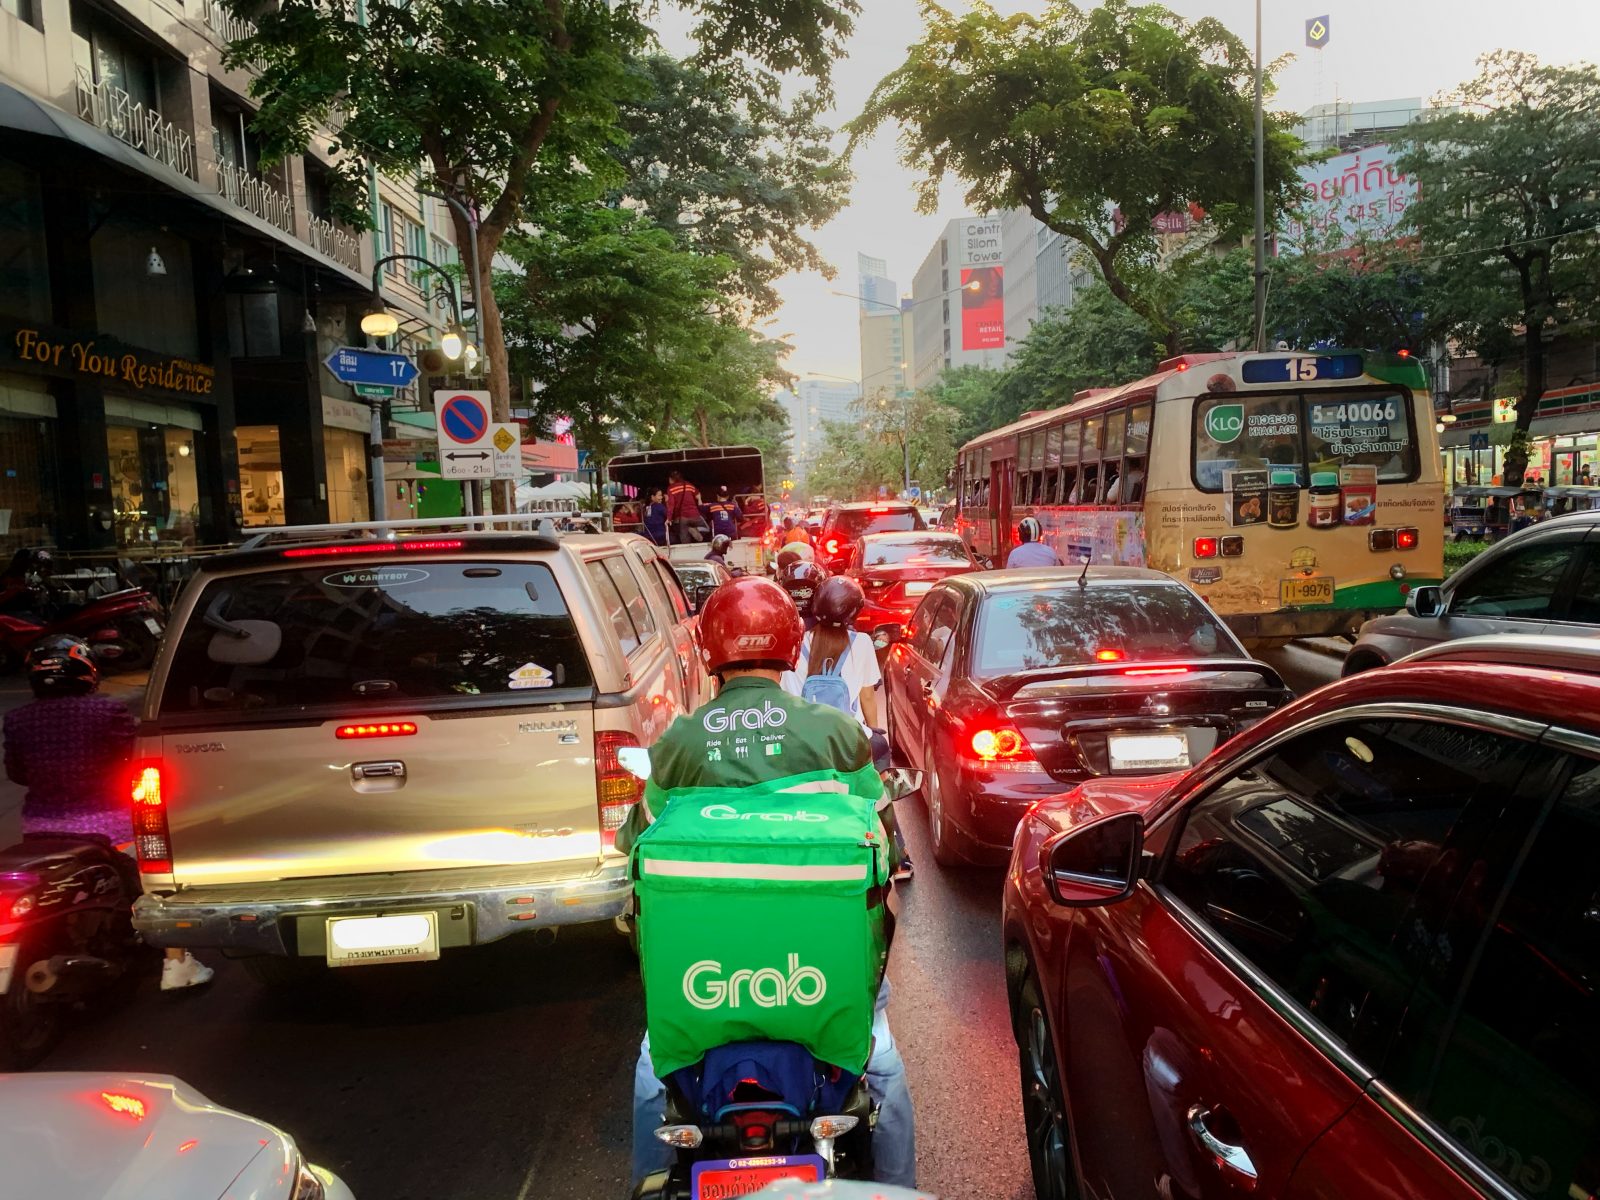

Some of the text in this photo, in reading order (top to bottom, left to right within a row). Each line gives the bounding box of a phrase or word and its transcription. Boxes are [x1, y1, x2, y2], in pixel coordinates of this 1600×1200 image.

[1302, 155, 1408, 202] ายที่ดิน
[1156, 218, 1182, 229] Silk
[967, 251, 1002, 262] Tower
[16, 329, 65, 366] For
[72, 341, 117, 376] You
[120, 354, 213, 393] Residence
[389, 360, 406, 377] 17
[1285, 358, 1318, 380] 15
[1208, 412, 1241, 432] KLO
[359, 572, 409, 582] CARRYBOY
[737, 635, 772, 646] STM
[703, 700, 787, 733] Grab
[175, 743, 226, 754] TOYOTA
[706, 739, 722, 748] Ride
[760, 732, 786, 742] Deliver
[701, 804, 829, 823] Grab
[682, 952, 827, 1010] Grab
